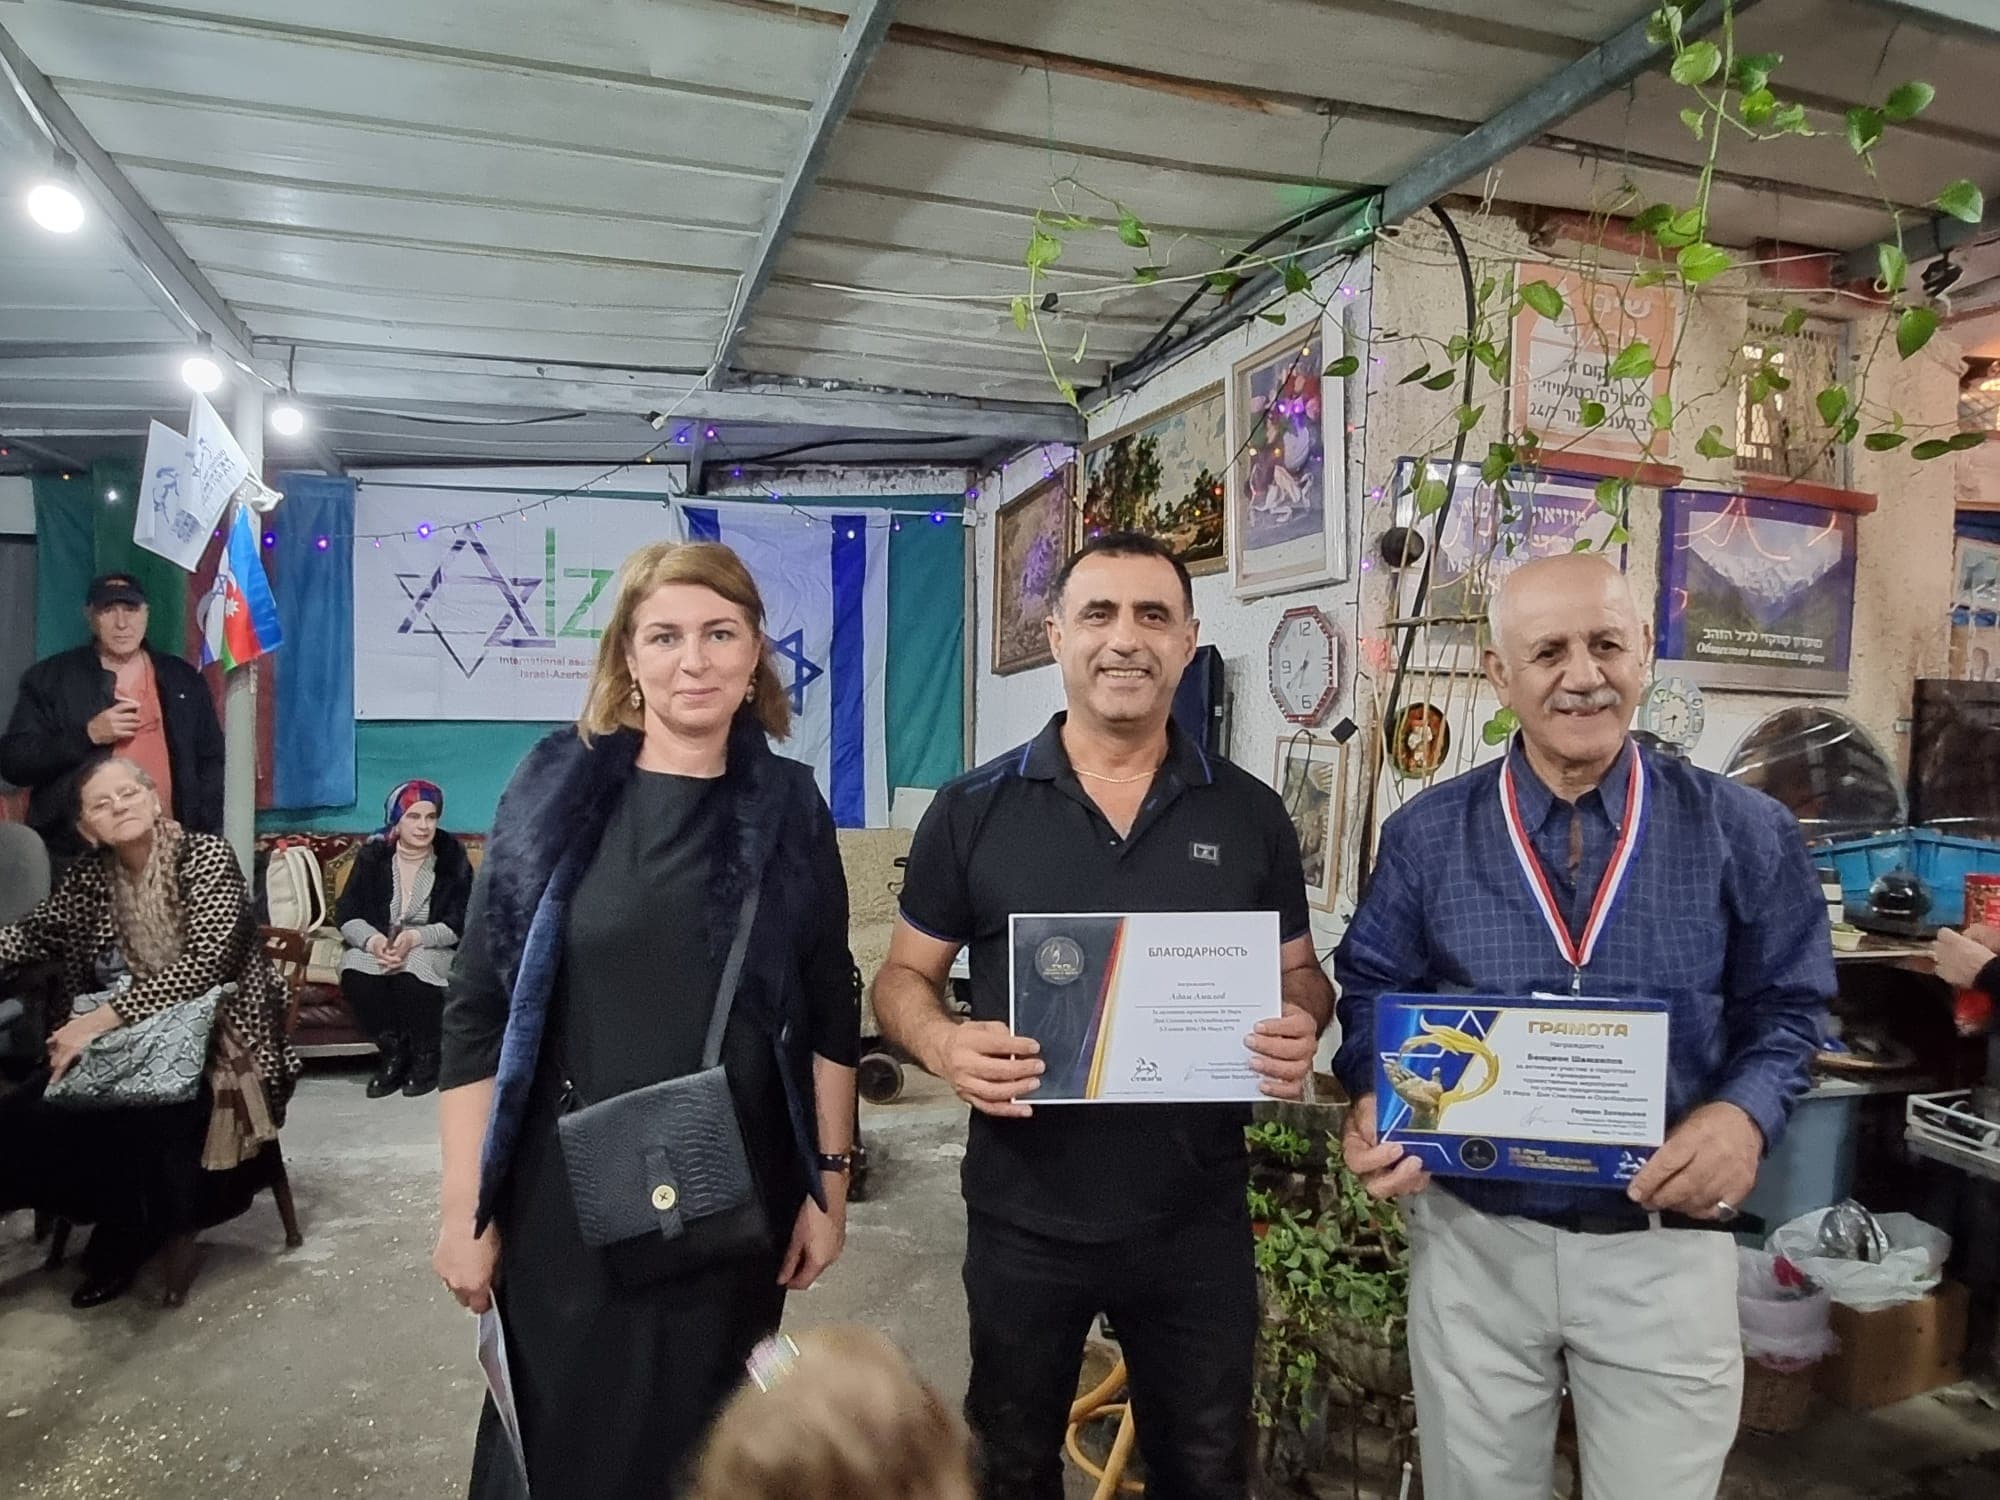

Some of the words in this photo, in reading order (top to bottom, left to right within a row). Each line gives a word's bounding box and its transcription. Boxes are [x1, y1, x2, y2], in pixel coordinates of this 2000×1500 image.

[1600, 387, 1646, 407] מצלם
[1299, 621, 1311, 636] 12
[499, 655, 566, 667] International
[1281, 660, 1291, 674] 9
[1301, 695, 1312, 709] 6
[1148, 946, 1248, 959] БЛАГОДАРНОСТЬ
[1527, 1021, 1629, 1037] ГРАМОТА
